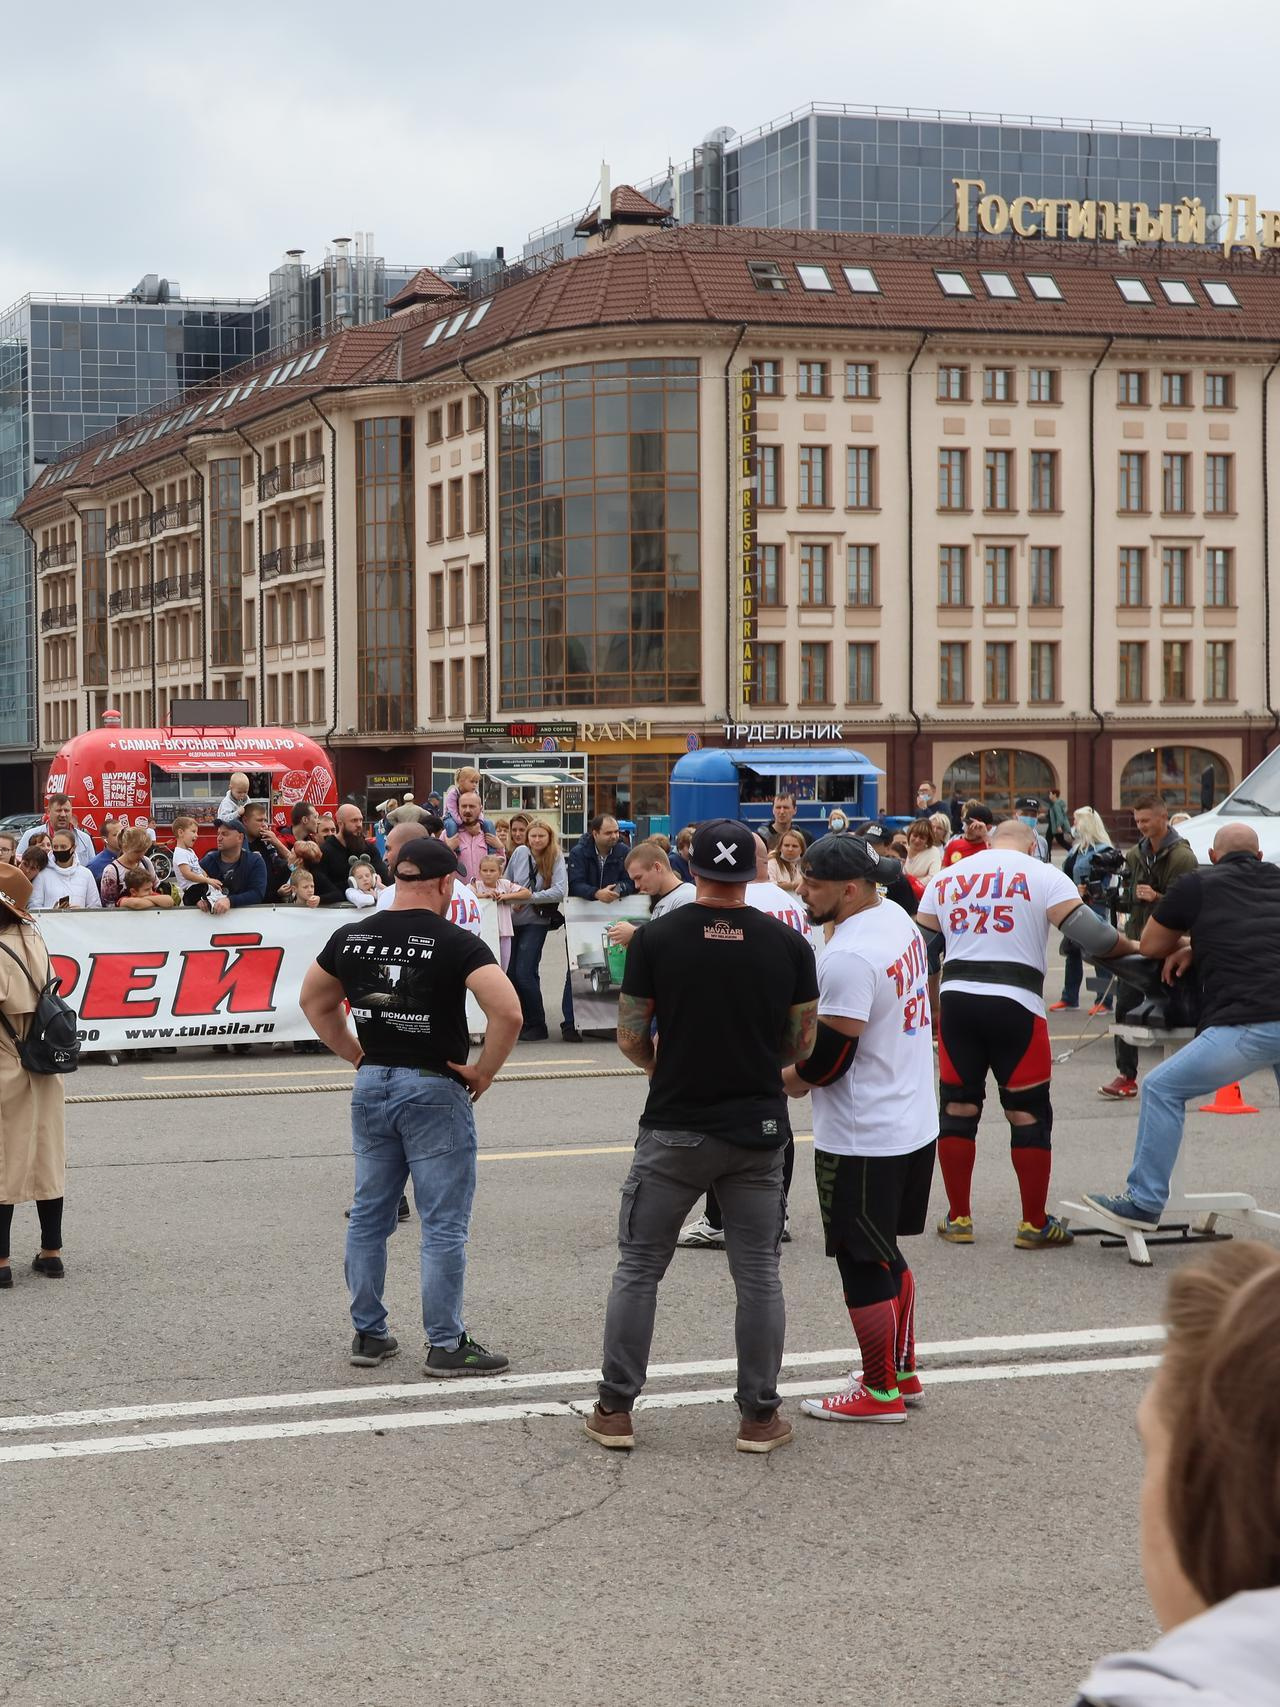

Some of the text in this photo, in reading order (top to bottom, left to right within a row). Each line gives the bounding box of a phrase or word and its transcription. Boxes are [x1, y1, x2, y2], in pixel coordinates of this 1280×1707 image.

[952, 177, 1206, 245] Гостиный
[742, 370, 752, 475] HOTEL
[742, 490, 752, 702] RESTAURANT
[723, 724, 843, 742] ТРДЕЛЬНИК
[47, 774, 66, 793] СВШ
[102, 772, 137, 780] ШАУРМА
[111, 783, 127, 793] ФРИ
[111, 792, 126, 800] КОФЕ
[935, 867, 1032, 905] ТУЛА
[950, 903, 1015, 934] 875
[704, 926, 743, 935] HAVATARI
[342, 945, 433, 959] FREEDOM
[886, 928, 928, 999] ТУЛ
[903, 982, 931, 1036] 87
[125, 1021, 276, 1040] www.tulasila.ru
